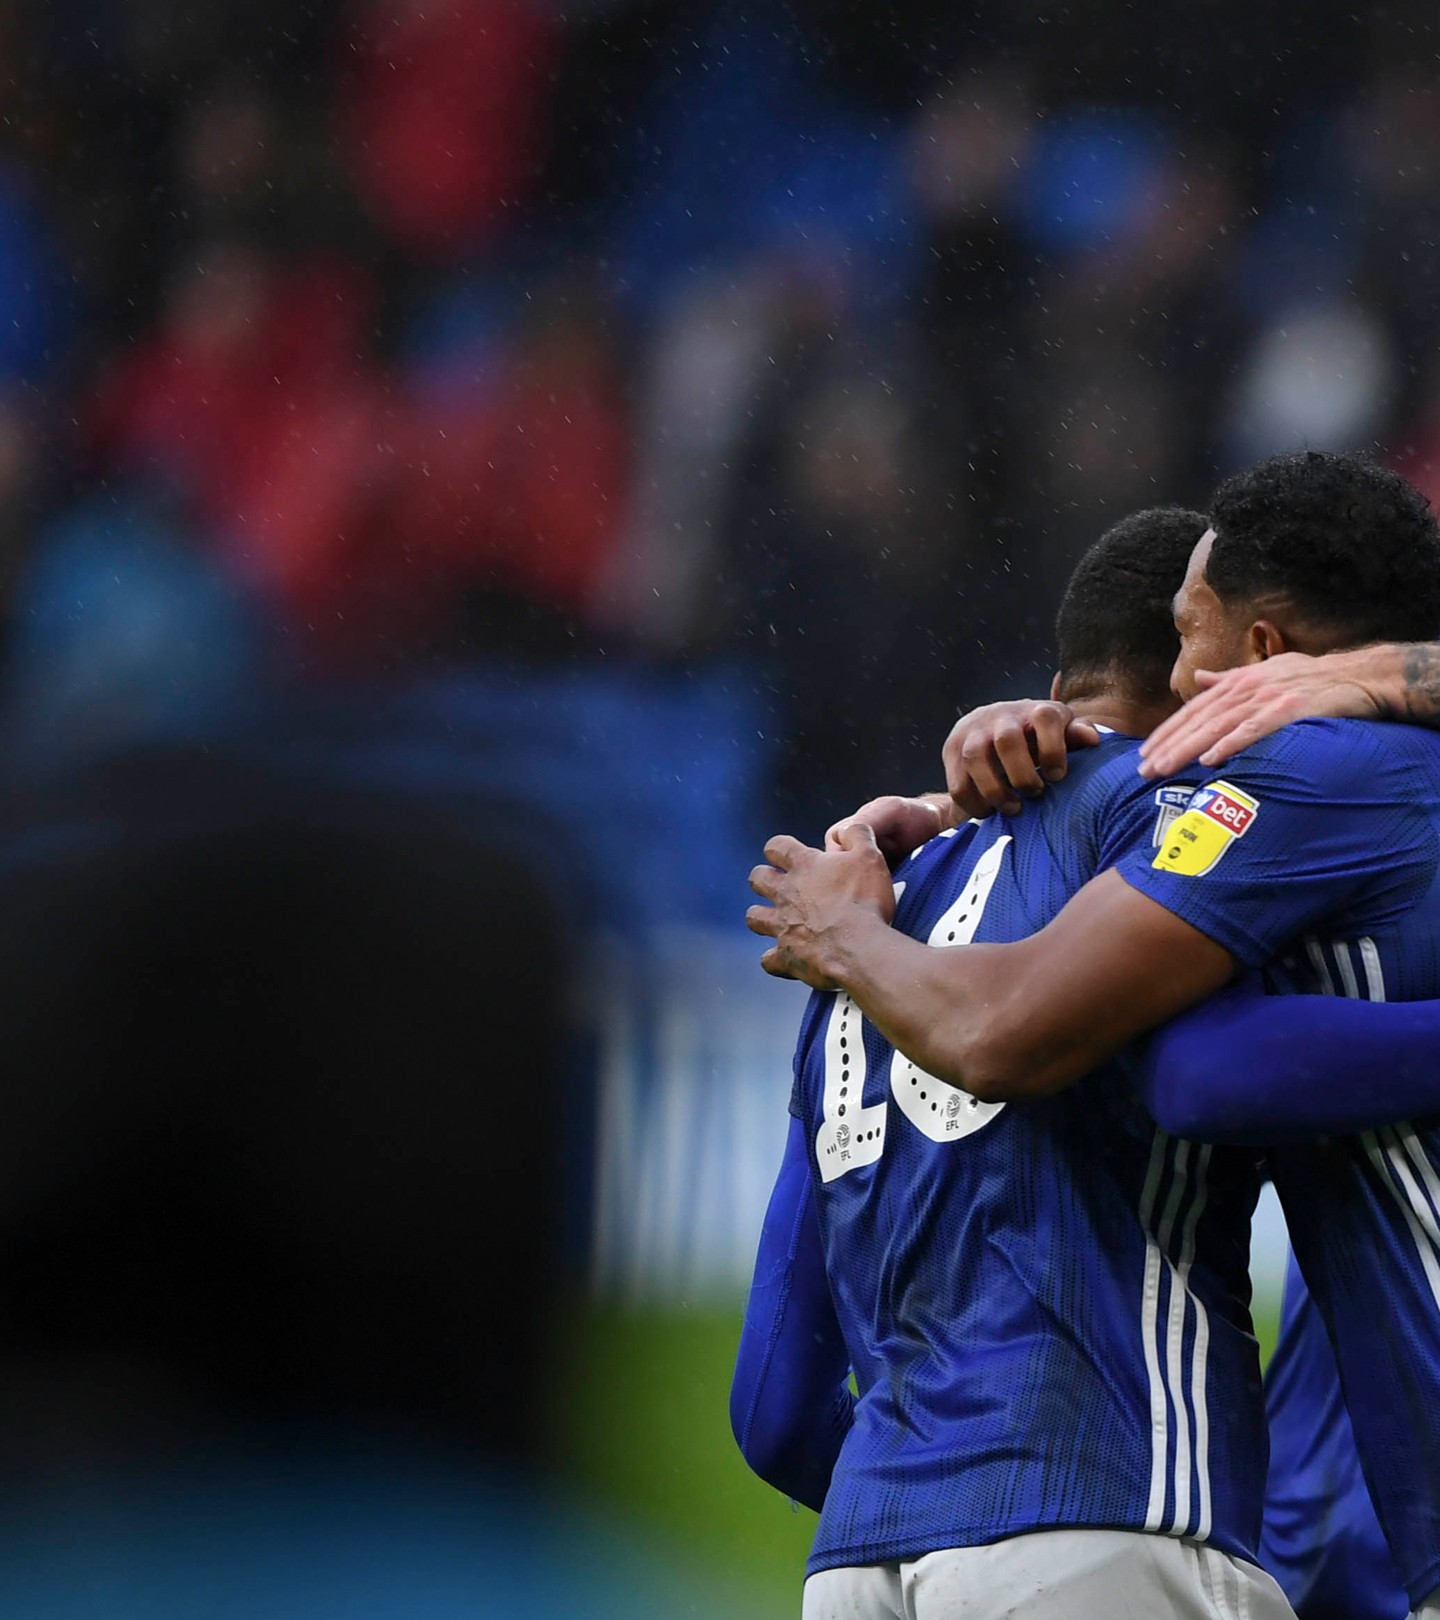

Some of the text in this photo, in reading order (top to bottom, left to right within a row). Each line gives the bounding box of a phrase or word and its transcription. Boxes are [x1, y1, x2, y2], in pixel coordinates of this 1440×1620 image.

[1164, 793, 1190, 806] sk
[1211, 796, 1247, 828] bet
[946, 1120, 959, 1131] EFL
